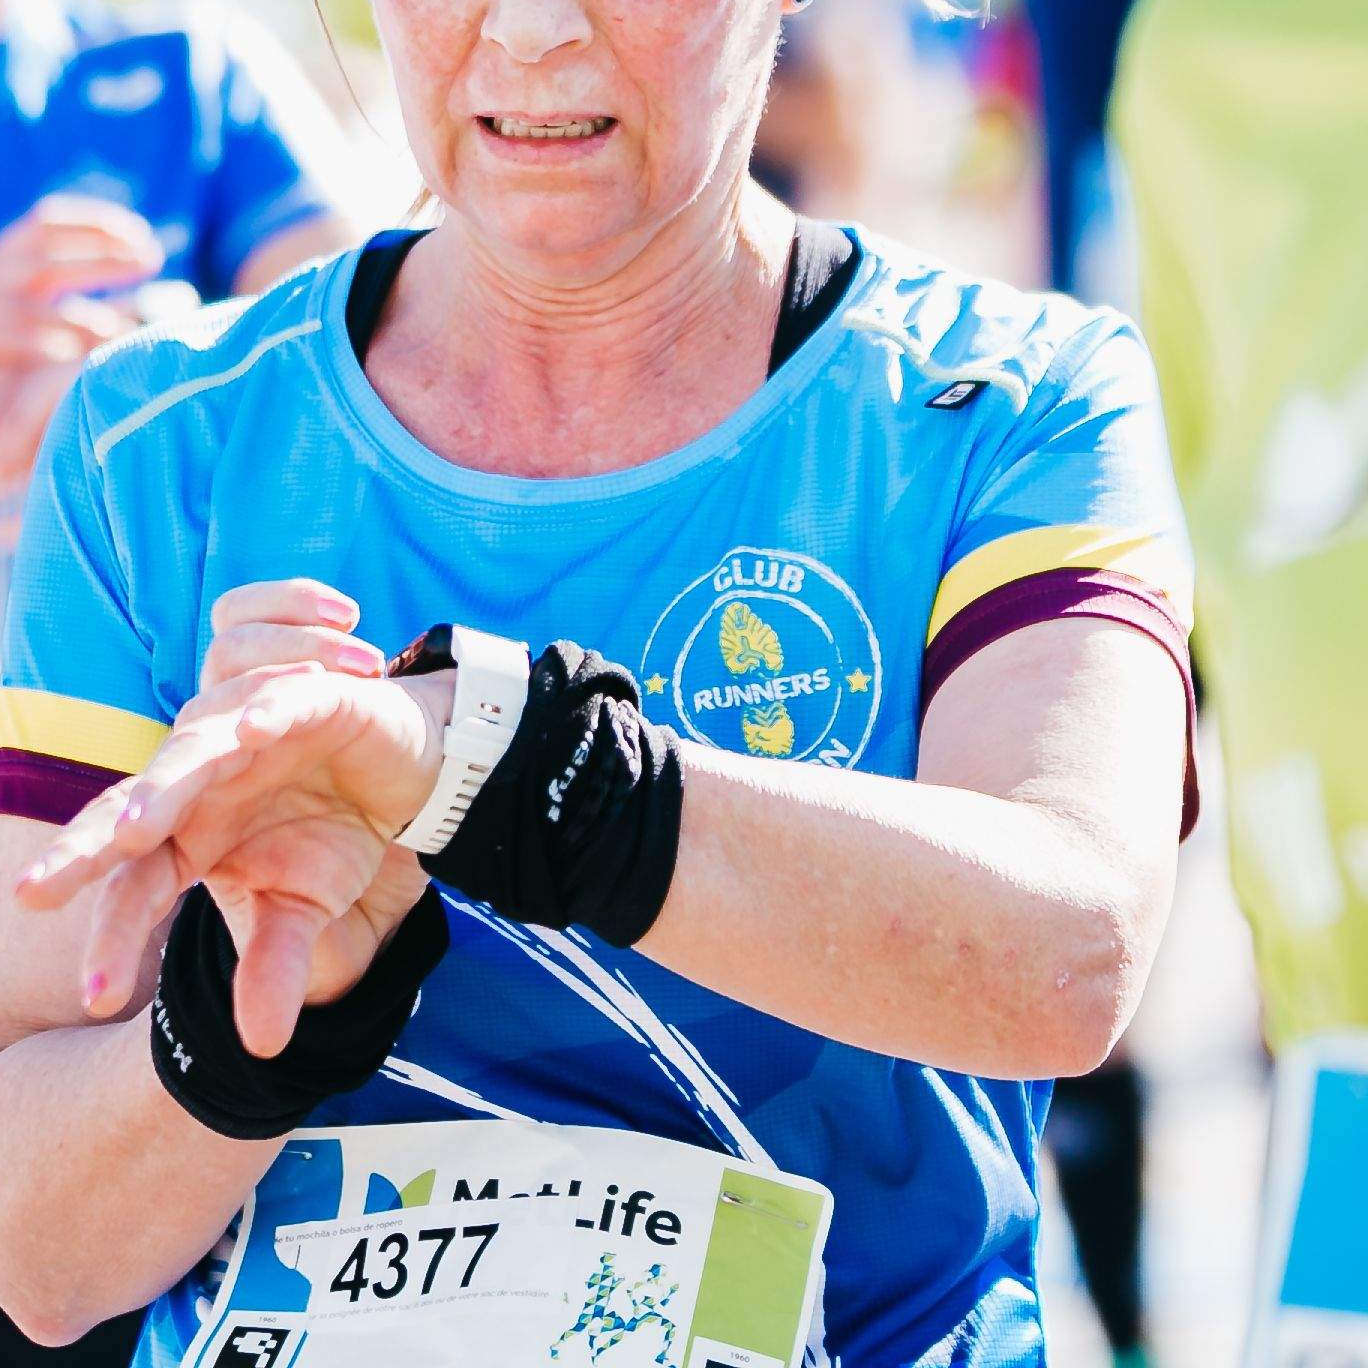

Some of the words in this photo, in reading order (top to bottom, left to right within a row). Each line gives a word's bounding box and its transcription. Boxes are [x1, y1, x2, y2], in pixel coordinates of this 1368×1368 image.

[712, 558, 806, 593] CLUB
[693, 668, 831, 714] RUNNERS
[297, 1231, 331, 1241] mochila
[340, 1225, 362, 1235] bolsa
[363, 1223, 374, 1231] de
[376, 1219, 403, 1231] ropero
[329, 1222, 500, 1303] 4377
